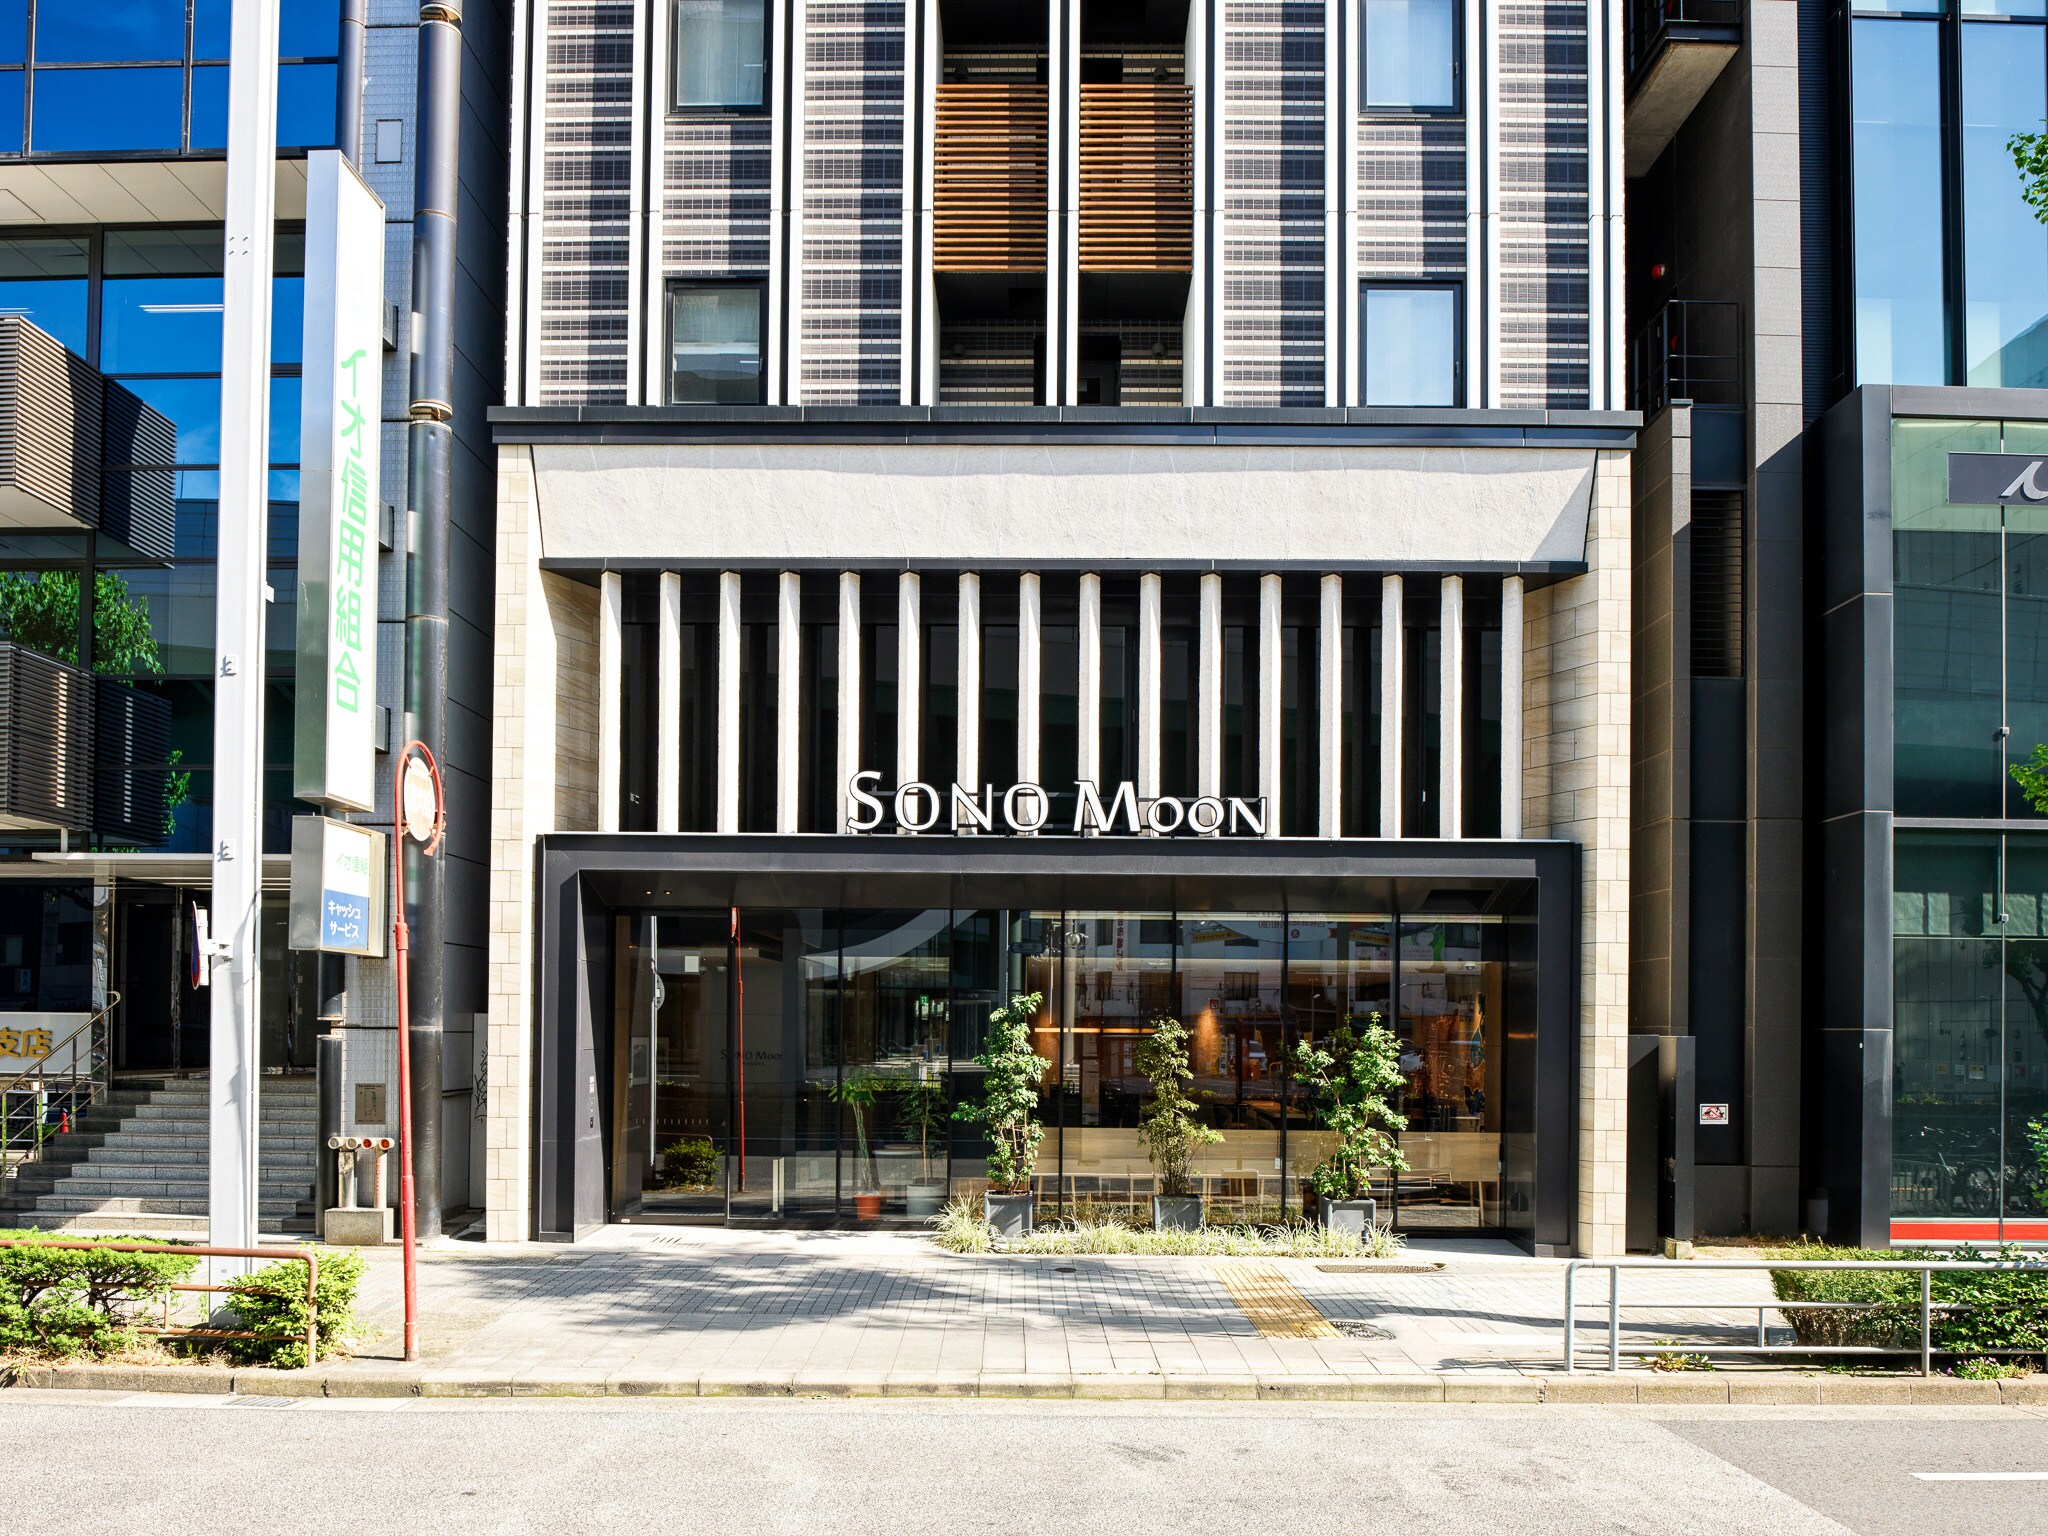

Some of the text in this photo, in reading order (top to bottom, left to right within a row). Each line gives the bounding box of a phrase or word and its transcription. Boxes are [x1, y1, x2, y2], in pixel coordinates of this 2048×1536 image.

[335, 349, 368, 713] イオ信用組合
[846, 771, 1049, 832] SONO
[327, 899, 361, 920] キャッシュ
[329, 920, 360, 939] サービス
